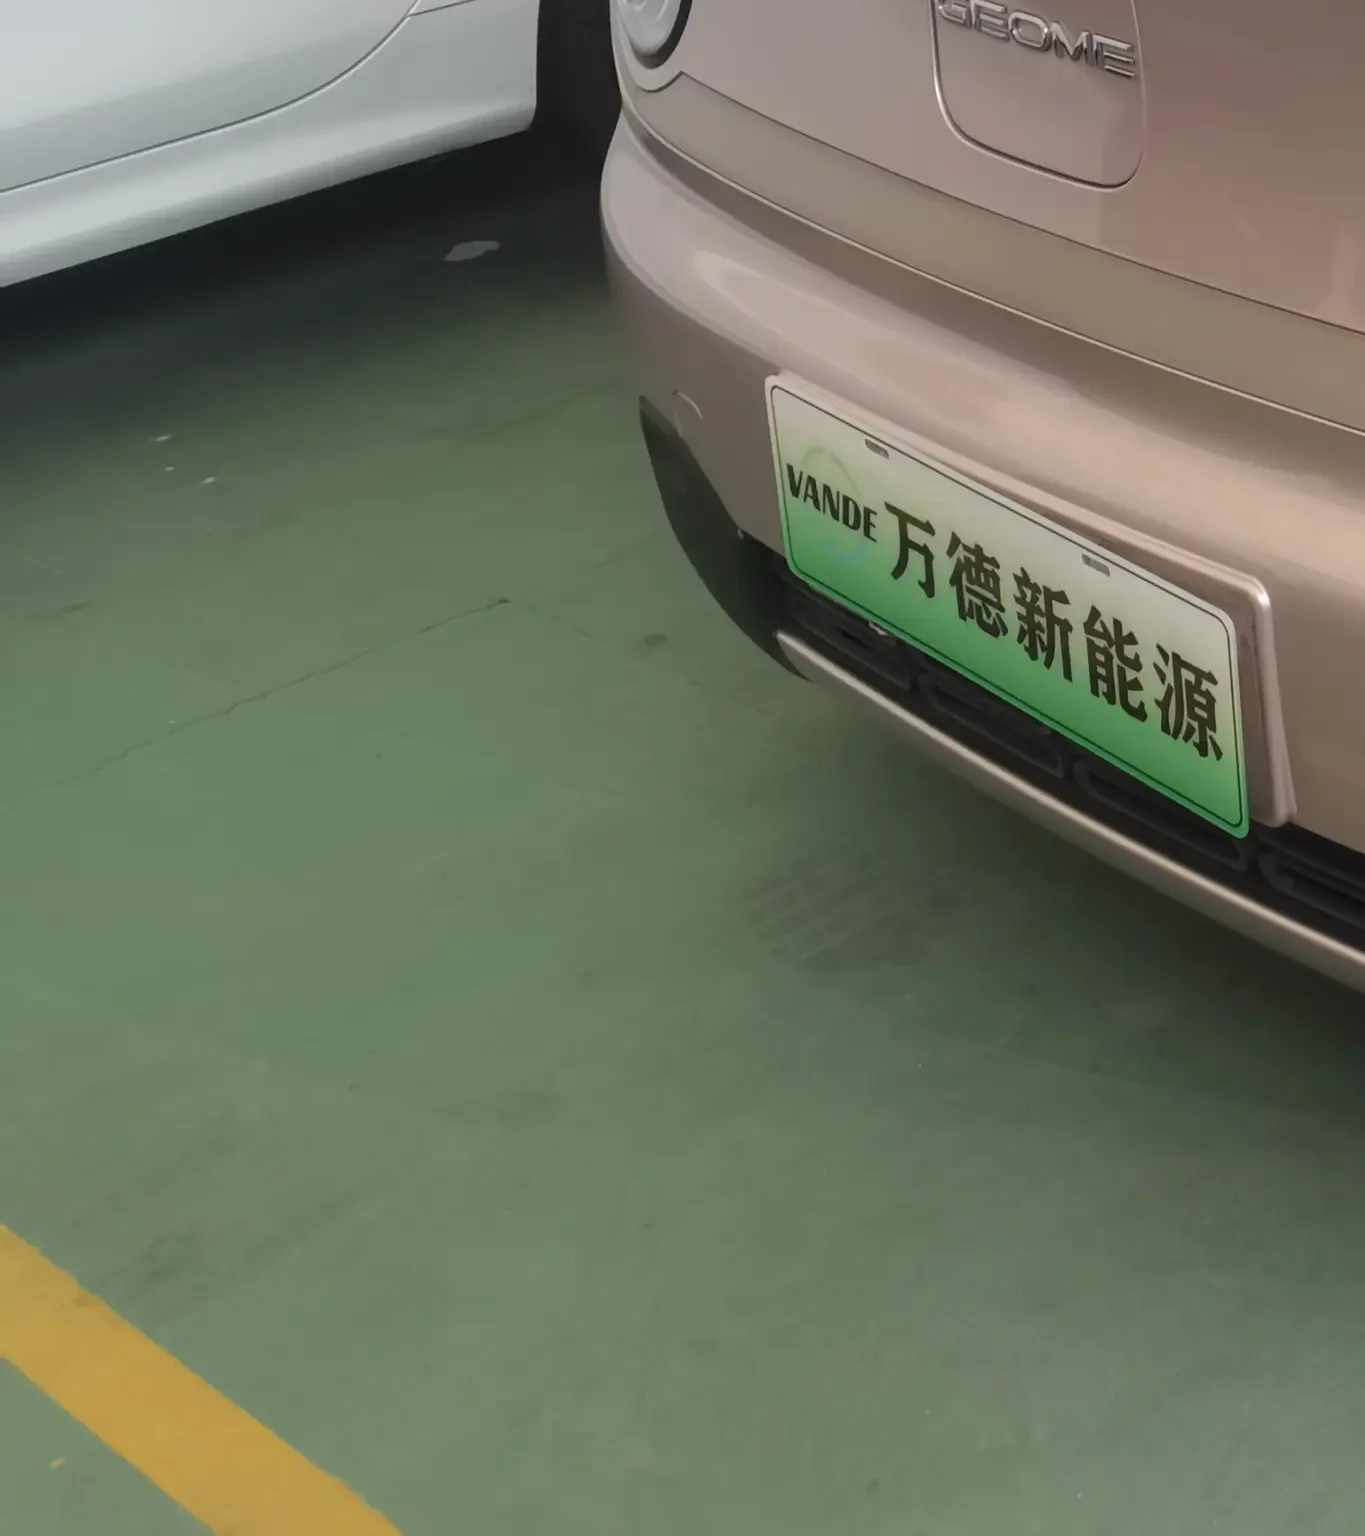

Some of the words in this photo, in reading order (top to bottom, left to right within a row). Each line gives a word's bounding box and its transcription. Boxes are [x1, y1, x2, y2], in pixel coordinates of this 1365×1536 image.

[787, 462, 879, 543] VANDE
[884, 500, 1224, 761] 万德新能源
